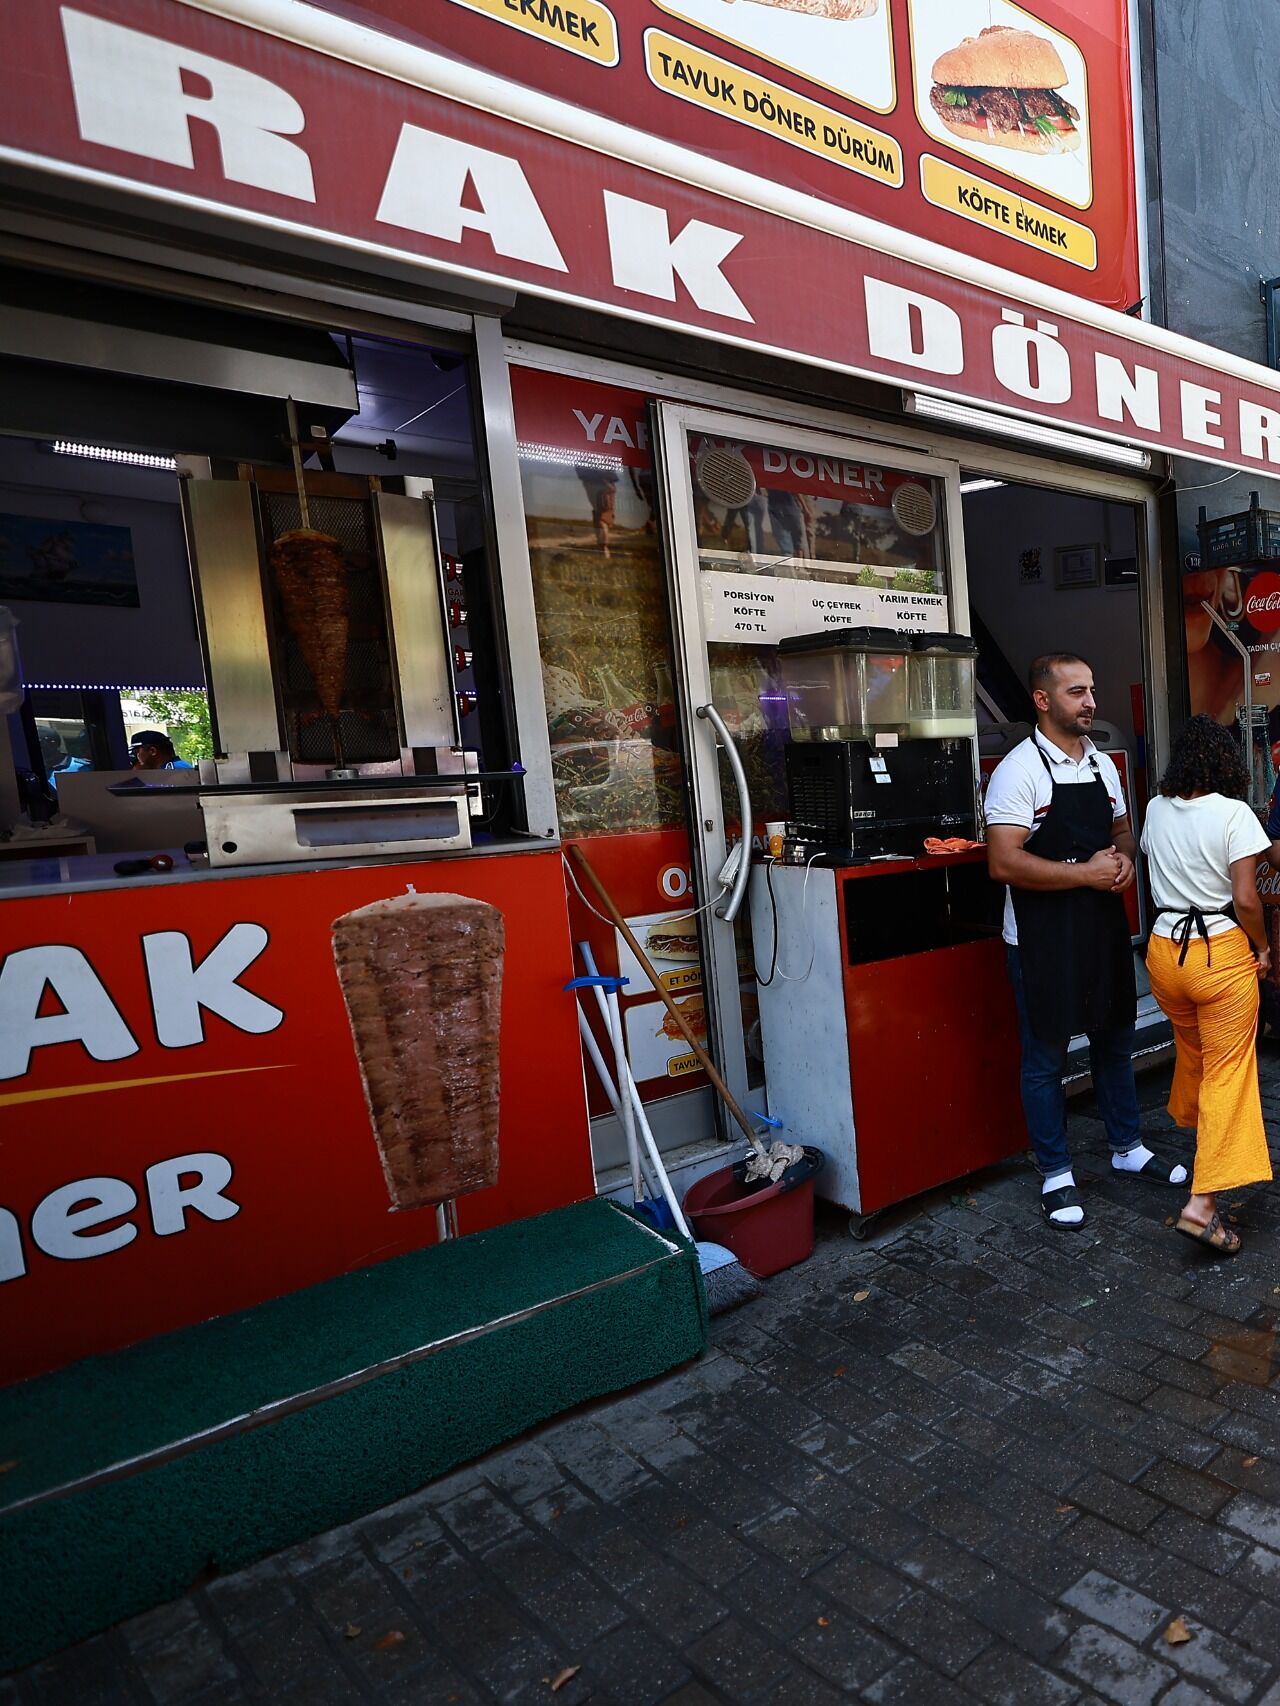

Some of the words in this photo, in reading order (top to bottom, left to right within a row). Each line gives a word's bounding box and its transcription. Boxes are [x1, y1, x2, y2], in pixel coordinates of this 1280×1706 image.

[658, 51, 735, 106] TAVUK
[743, 87, 818, 141] DÖNER
[823, 121, 895, 175] DÜRÜM
[60, 5, 756, 325] RAK
[957, 185, 1011, 228] KÖFTE
[1015, 209, 1068, 250] EKMEK
[723, 590, 775, 603] PORSİYON
[878, 594, 909, 604] YARIM
[911, 596, 943, 606] EKMEK
[811, 599, 825, 609] ÜÇ
[827, 601, 862, 611] ÇEYREK
[733, 606, 767, 617] KÖFTE
[896, 610, 927, 621] KÖFTE
[823, 614, 852, 624] KÖFTE
[734, 622, 752, 632] 470
[754, 623, 767, 632] TL
[669, 976, 681, 986] ET
[683, 971, 701, 984] DÖ
[0, 921, 285, 1081] AK
